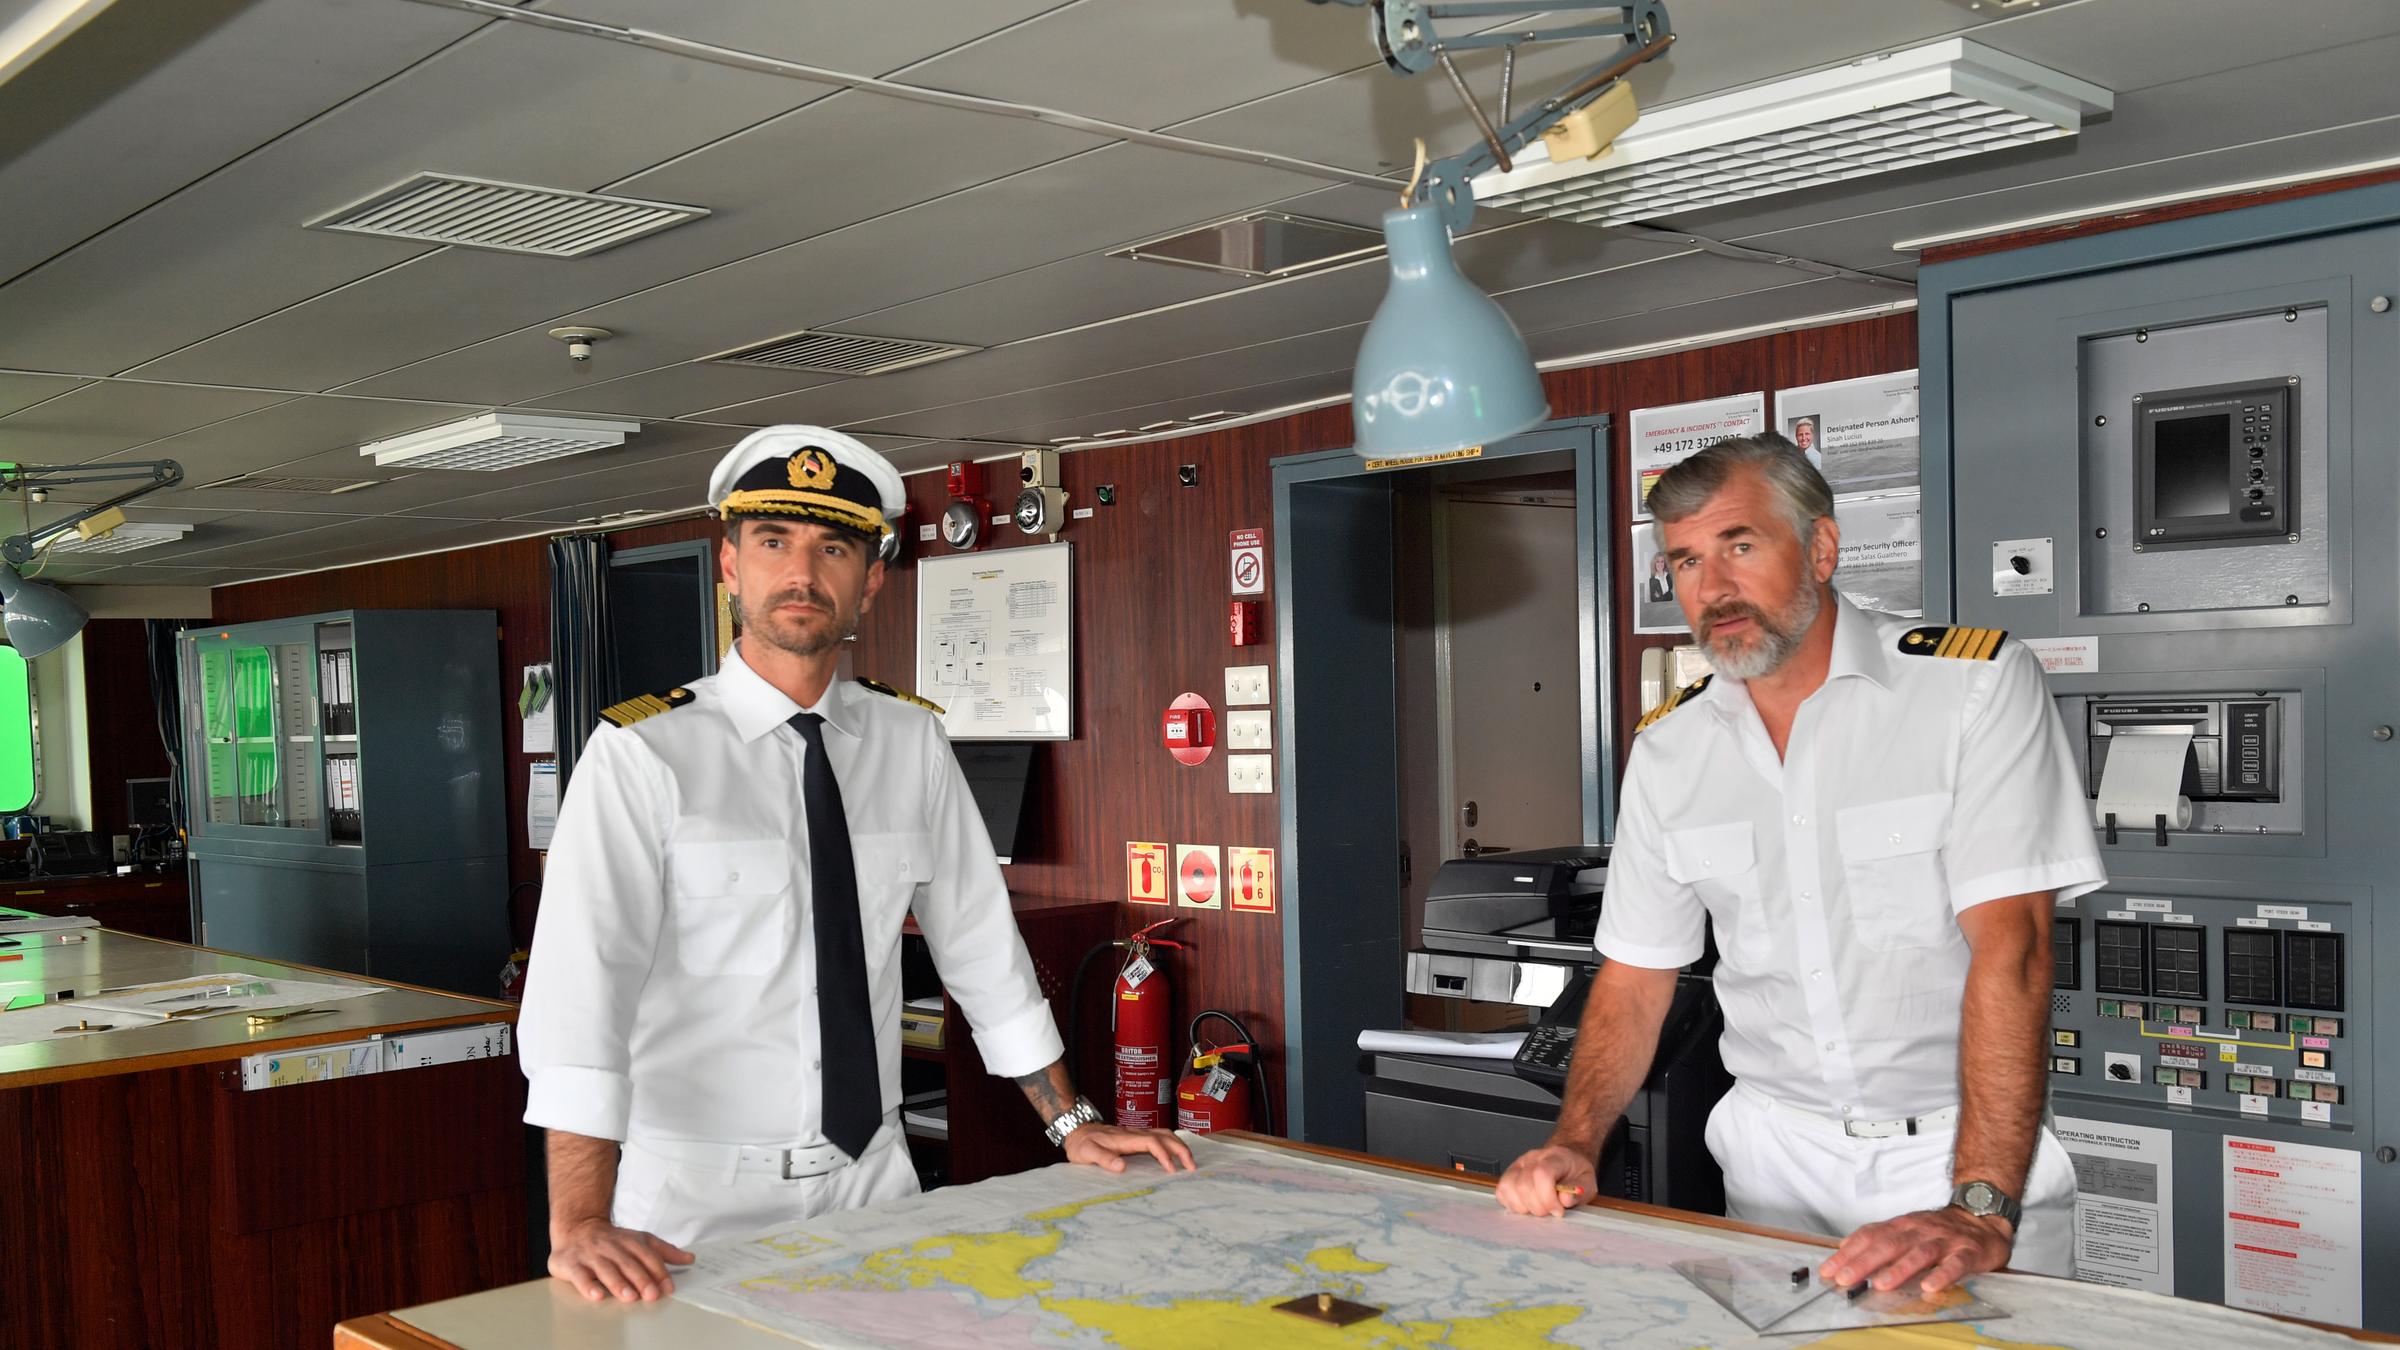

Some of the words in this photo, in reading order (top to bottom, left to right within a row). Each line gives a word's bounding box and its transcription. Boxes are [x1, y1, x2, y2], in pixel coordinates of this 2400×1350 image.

[1645, 427, 1679, 437] EMERGENCY
[1723, 418, 1751, 428] CONTACT
[1827, 422, 1864, 433] Designated
[1866, 420, 1889, 428] Person
[1654, 442, 1672, 453] +49
[1675, 440, 1693, 452] 172
[1838, 545, 1861, 554] mpany
[1863, 542, 1890, 550] Security
[1892, 540, 1918, 548] Officer:
[1257, 871, 1264, 882] P
[1257, 888, 1264, 899] 6
[483, 1036, 491, 1056] nder
[2057, 1130, 2094, 1140] OPERATING
[2096, 1134, 2140, 1146] INSTRUCTION
[2104, 1142, 2126, 1150] STEERING
